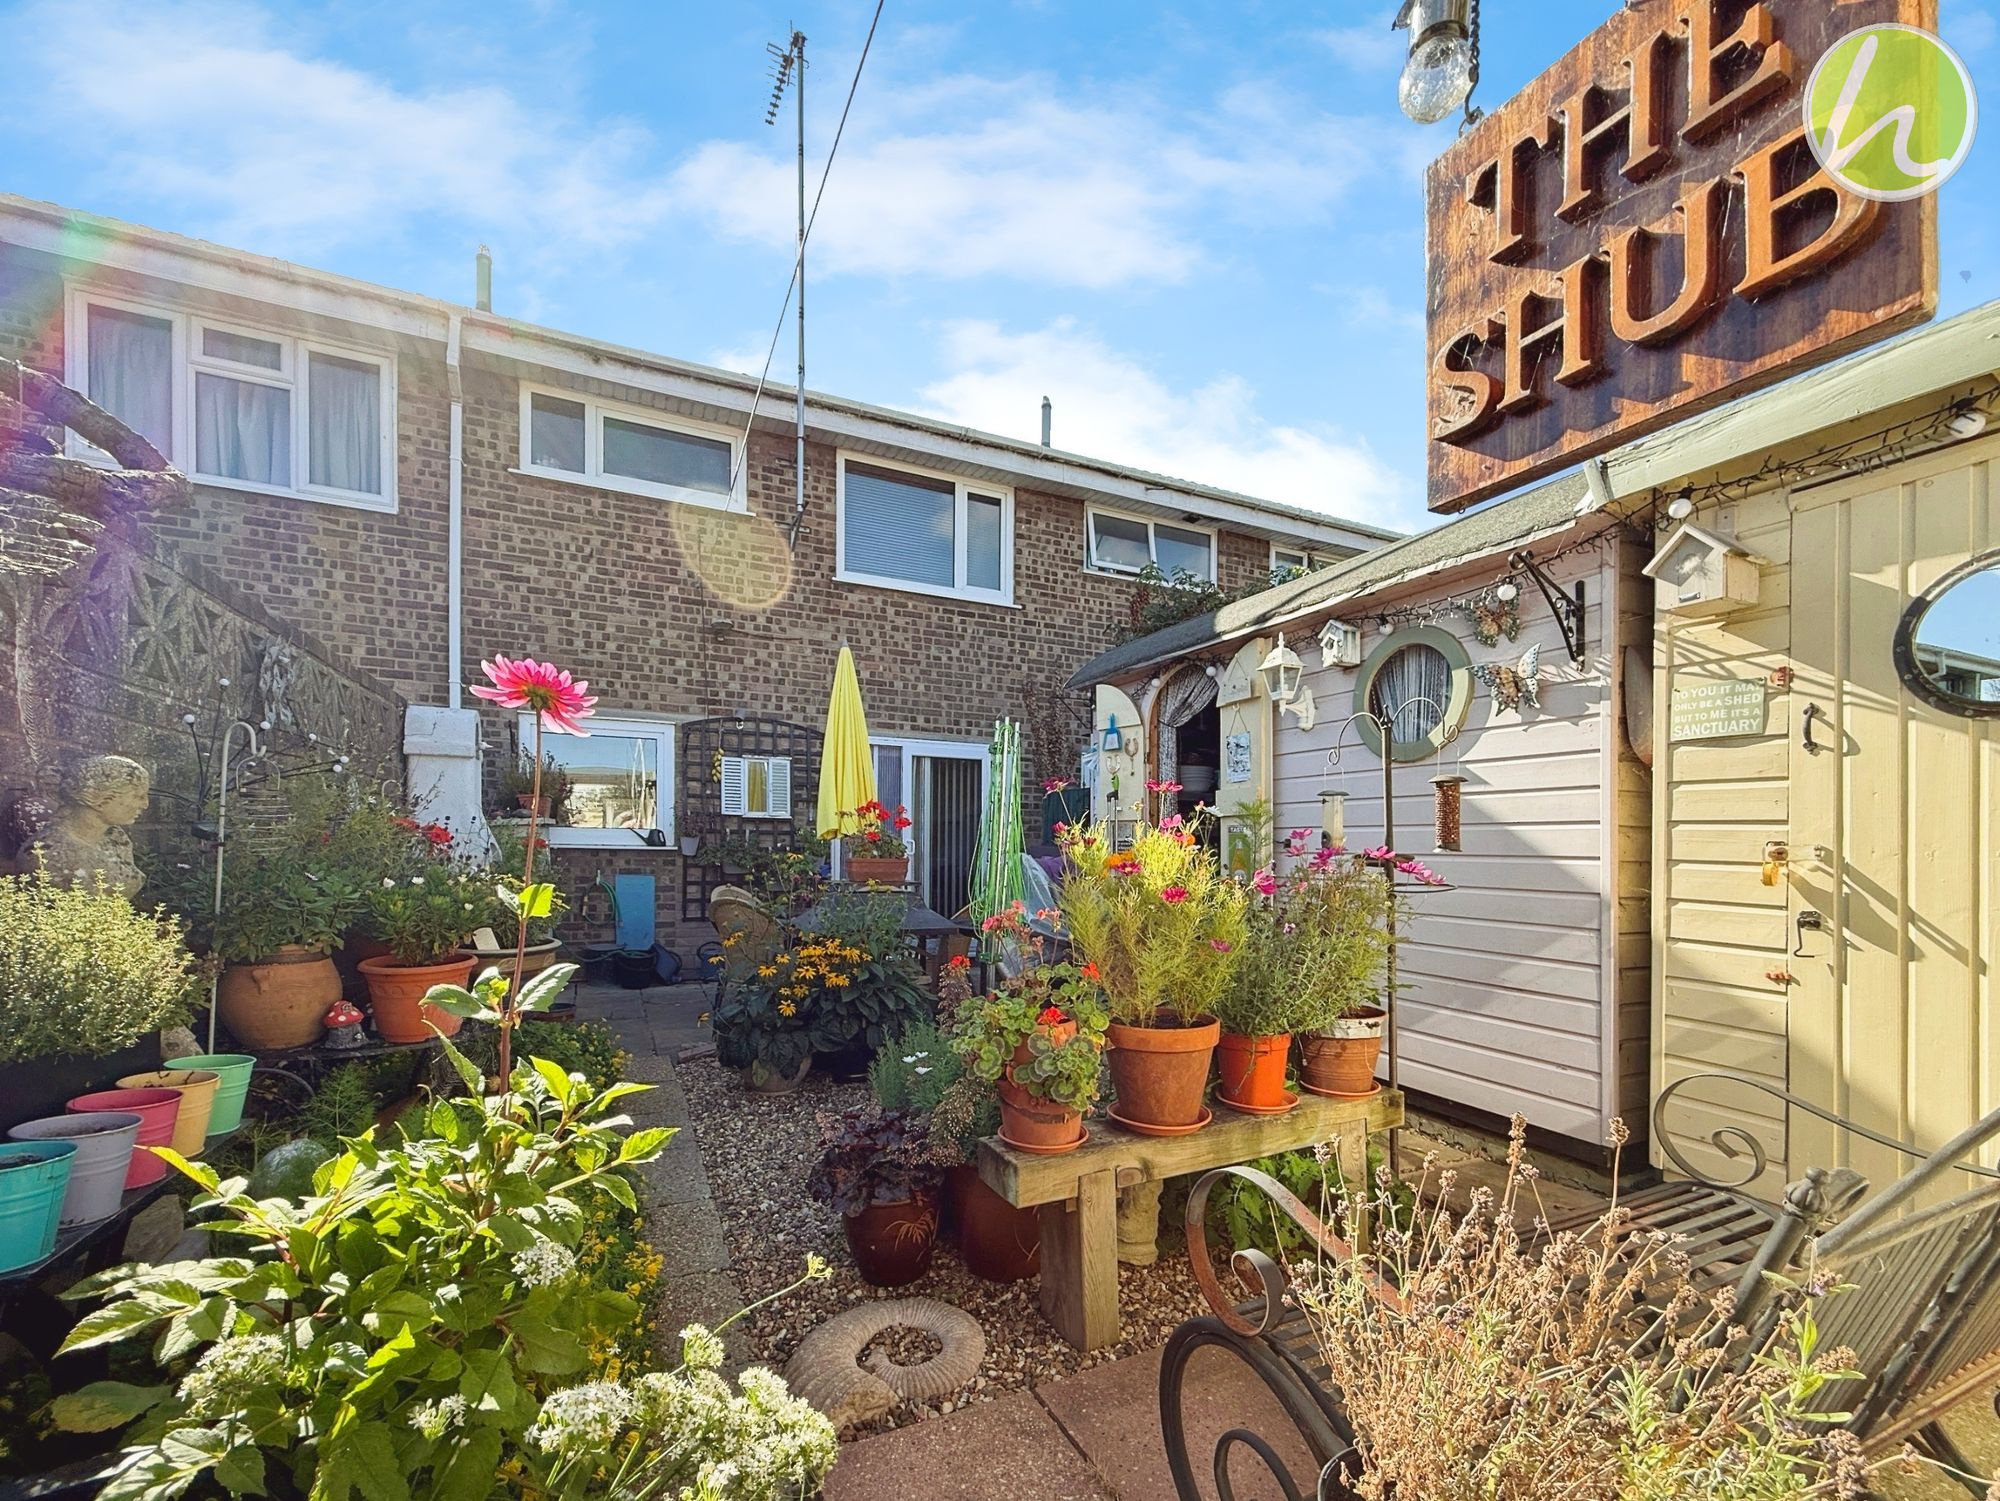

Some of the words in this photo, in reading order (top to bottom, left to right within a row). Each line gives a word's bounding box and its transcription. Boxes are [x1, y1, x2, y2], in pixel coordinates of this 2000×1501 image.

[1466, 0, 1792, 263] THE
[1432, 122, 1879, 445] SHUB
[1675, 690, 1688, 700] TO
[1691, 686, 1716, 698] YOU
[1720, 685, 1732, 694] IT
[1674, 702, 1697, 712] ONLY
[1699, 700, 1713, 708] BE
[1715, 699, 1722, 707] A
[1725, 693, 1761, 706] SHED
[1674, 714, 1693, 723] BUT
[1695, 712, 1708, 721] TO
[1710, 710, 1727, 719] ME
[1731, 708, 1749, 717] IT'S
[1753, 707, 1760, 715] A
[1674, 718, 1760, 738] SANCTUARY
